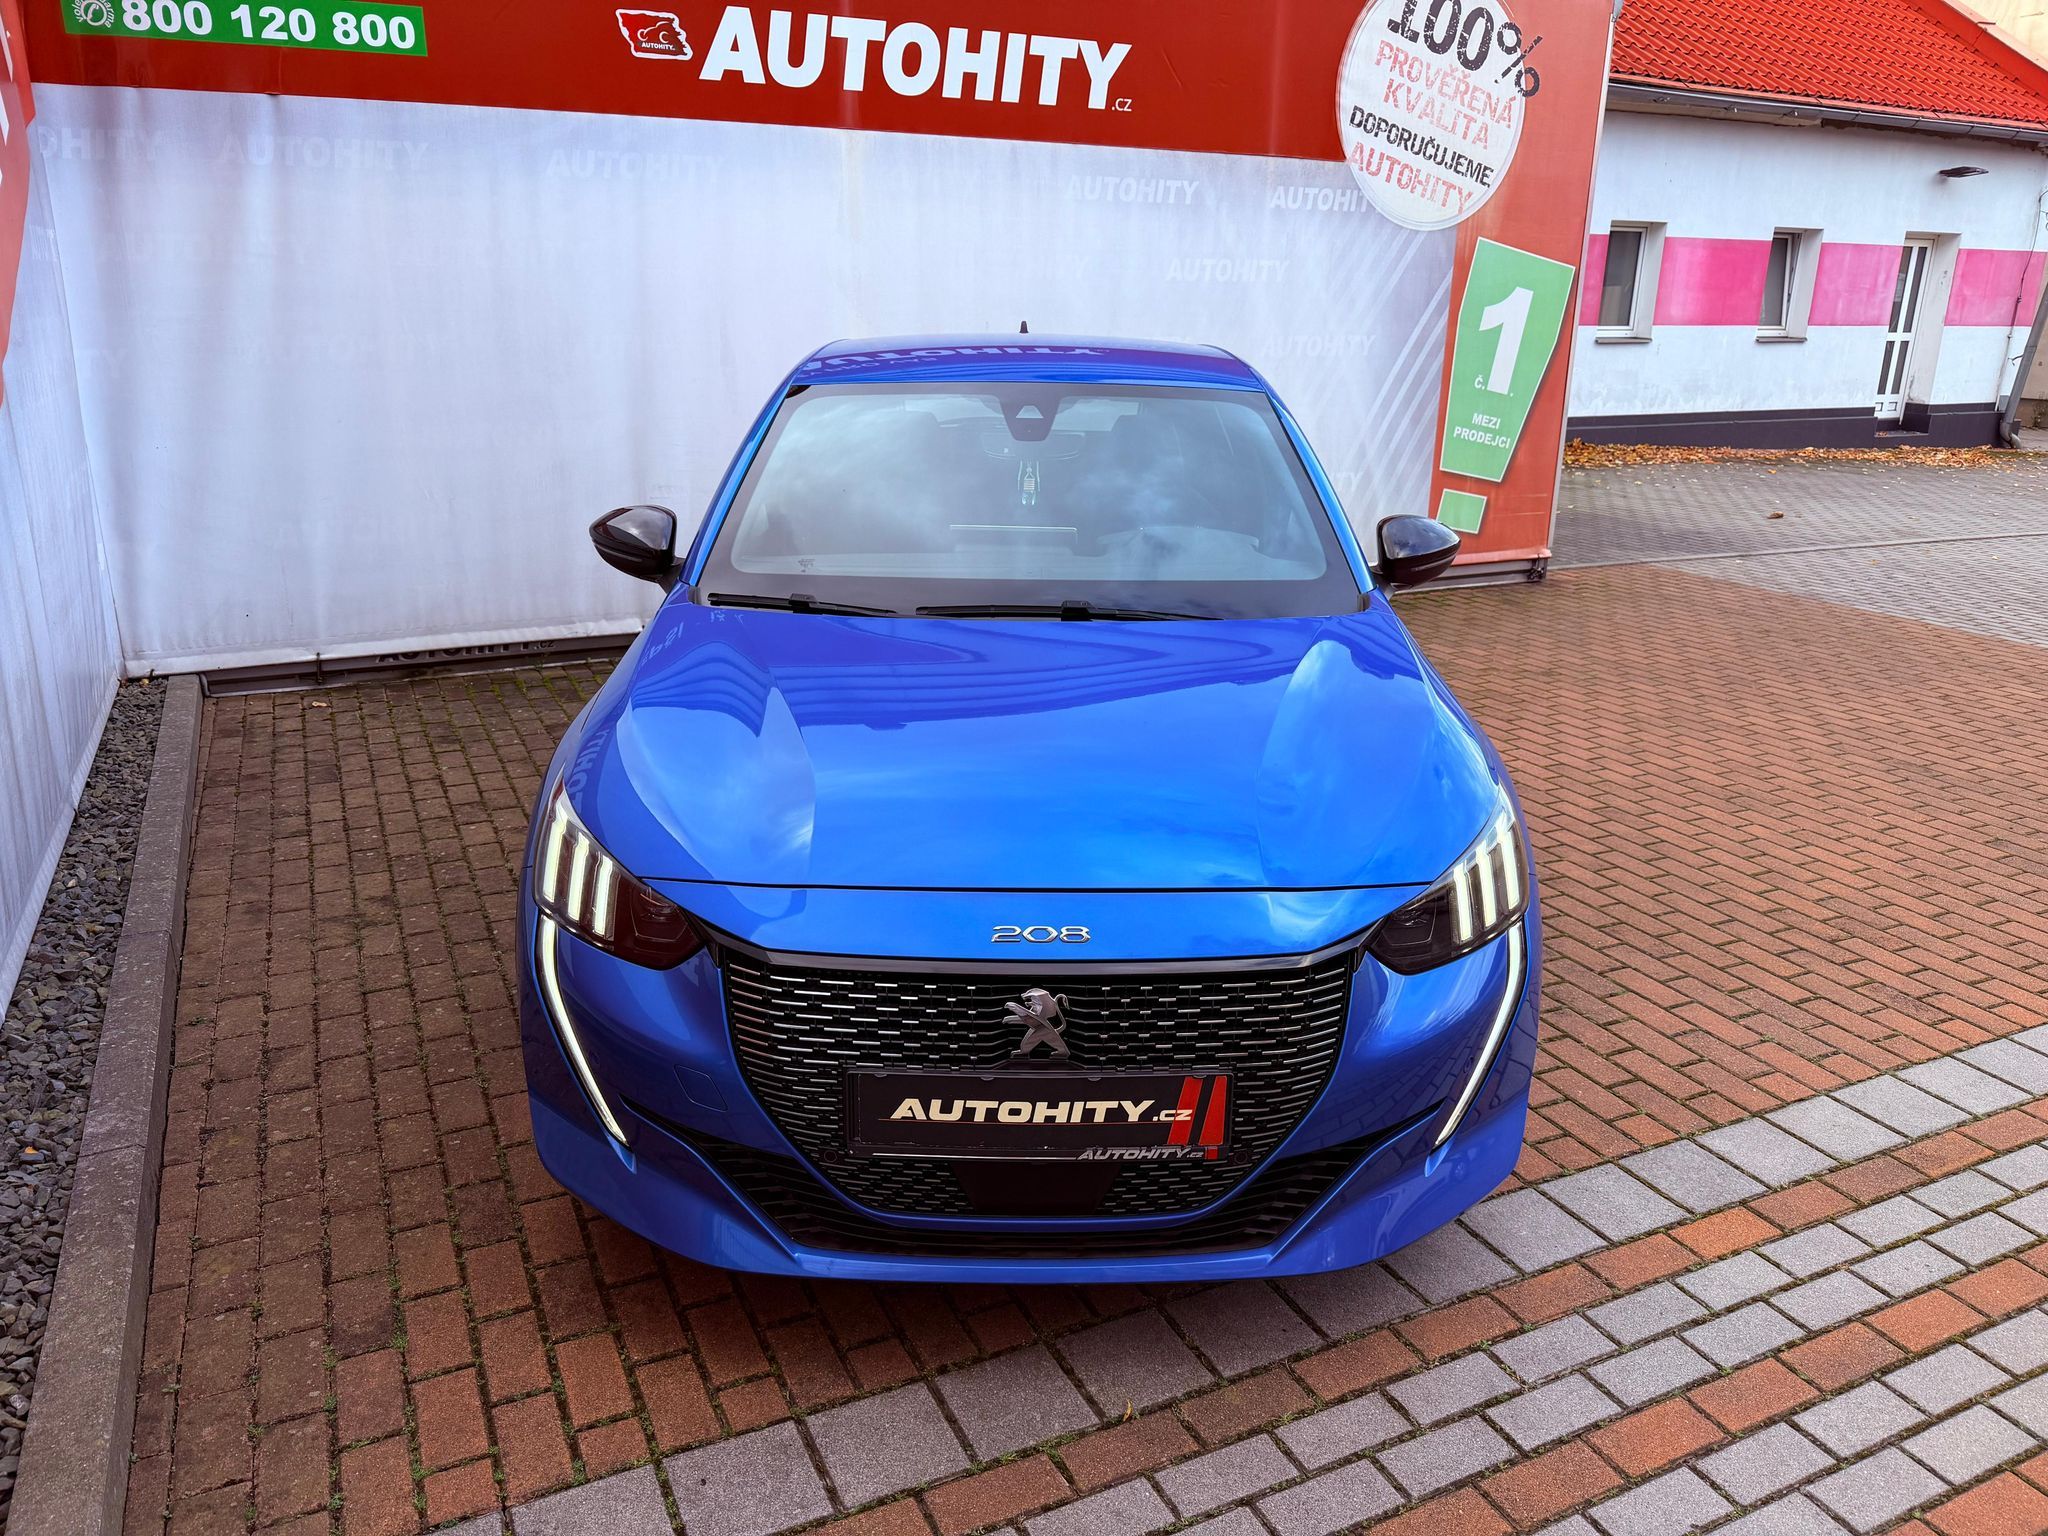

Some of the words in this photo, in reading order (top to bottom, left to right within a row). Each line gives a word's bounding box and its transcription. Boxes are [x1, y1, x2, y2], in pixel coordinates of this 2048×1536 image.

[121, 0, 213, 36] 800
[230, 4, 317, 42] 120
[332, 11, 416, 49] 800
[1387, 0, 1543, 98] 100%
[1375, 40, 1517, 129] PROVĚŘENÁ
[1383, 78, 1490, 150] KVALITA
[1349, 105, 1495, 189] DOPORUČUJEME
[1065, 175, 1199, 205] AUTOHITY
[1351, 142, 1474, 215] AUTOHITY
[1270, 186, 1378, 213] AUTOHIT
[1165, 258, 1289, 283] AUTOHITY
[1472, 413, 1501, 430] MEZI
[1453, 426, 1511, 449] PRODEJCI
[991, 925, 1092, 943] 208
[890, 1098, 1193, 1123] AUTOHITY.cz
